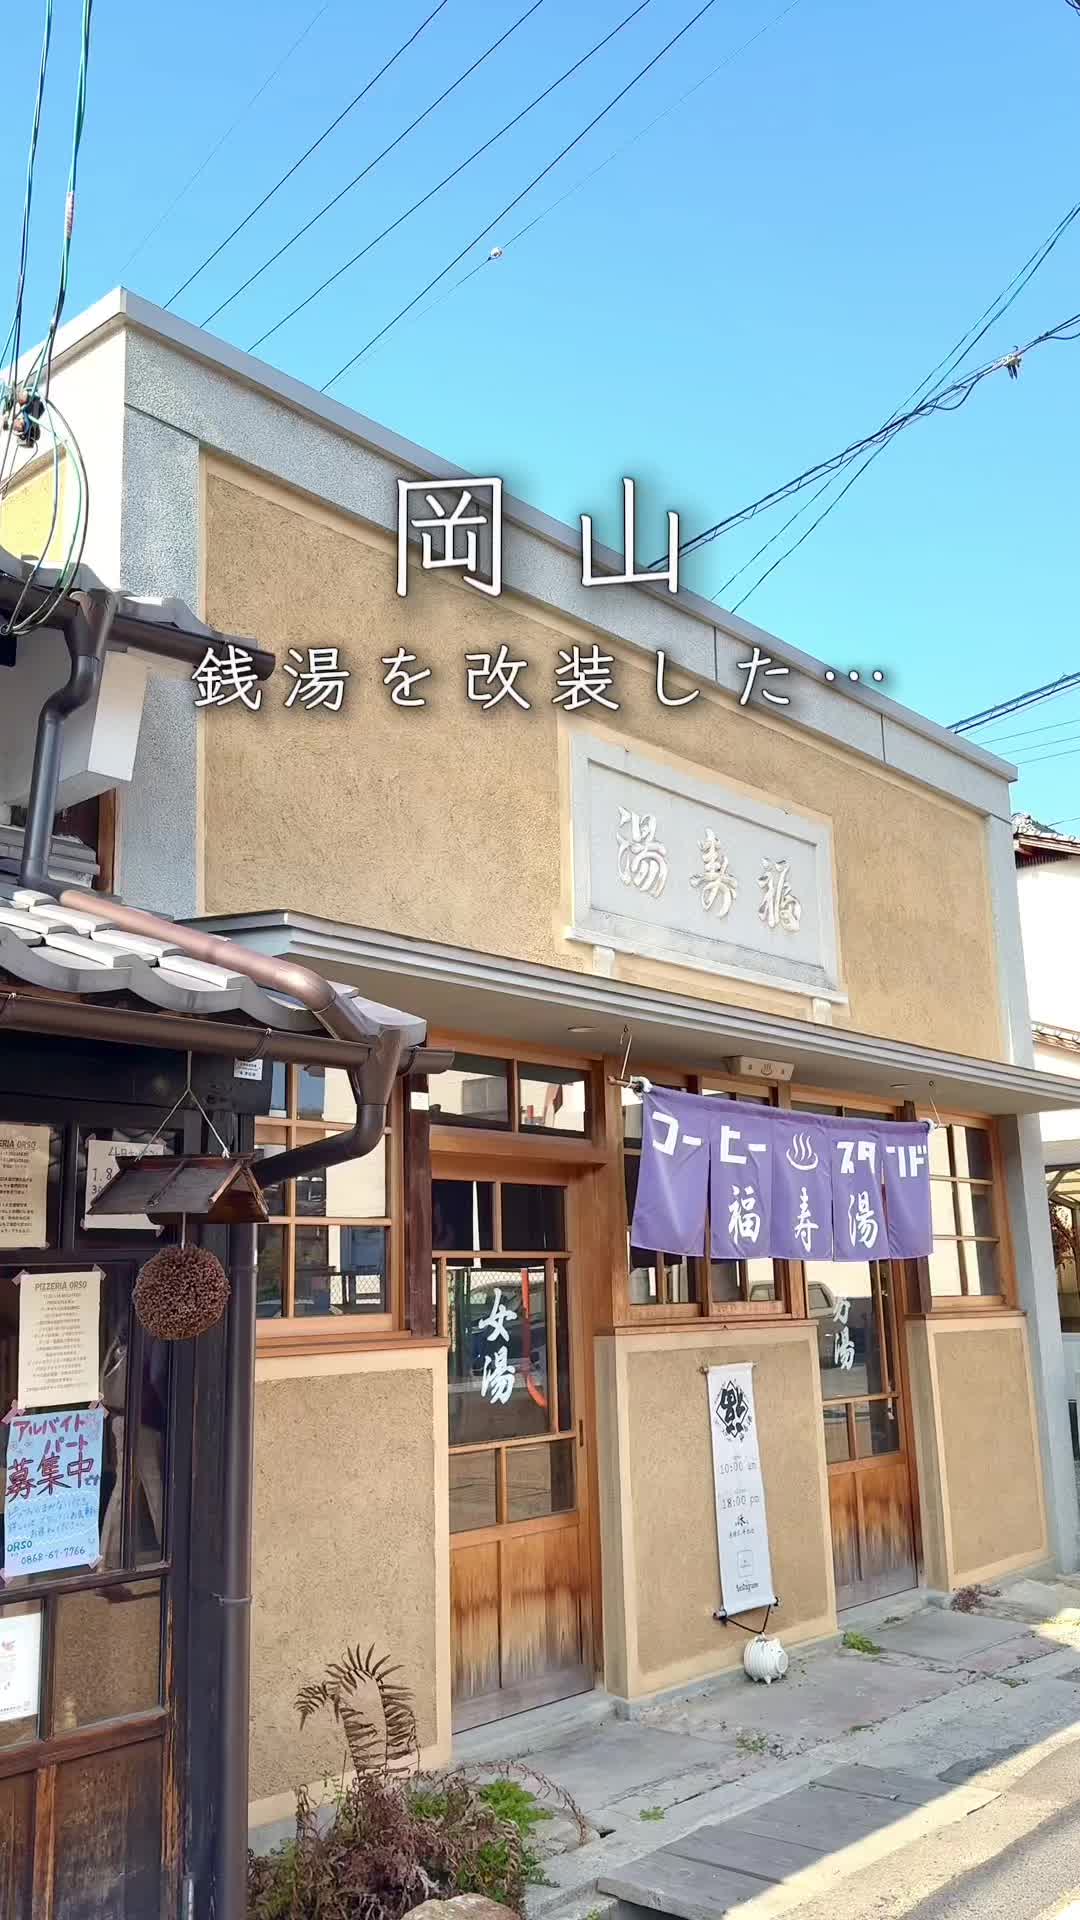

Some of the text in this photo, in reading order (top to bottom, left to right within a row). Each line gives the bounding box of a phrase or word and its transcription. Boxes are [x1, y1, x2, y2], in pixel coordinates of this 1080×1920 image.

[651, 1110, 767, 1165] コーヒー
[728, 1185, 878, 1252] 福寿湯
[35, 1280, 87, 1292] PIZZERIA ORSO
[478, 1287, 517, 1405] 女湯
[13, 1413, 86, 1441] アルバイト
[44, 1434, 88, 1456] パート
[720, 1462, 744, 1475] 10:00
[721, 1495, 746, 1509] 18:00
[7, 1540, 33, 1557] ORSO
